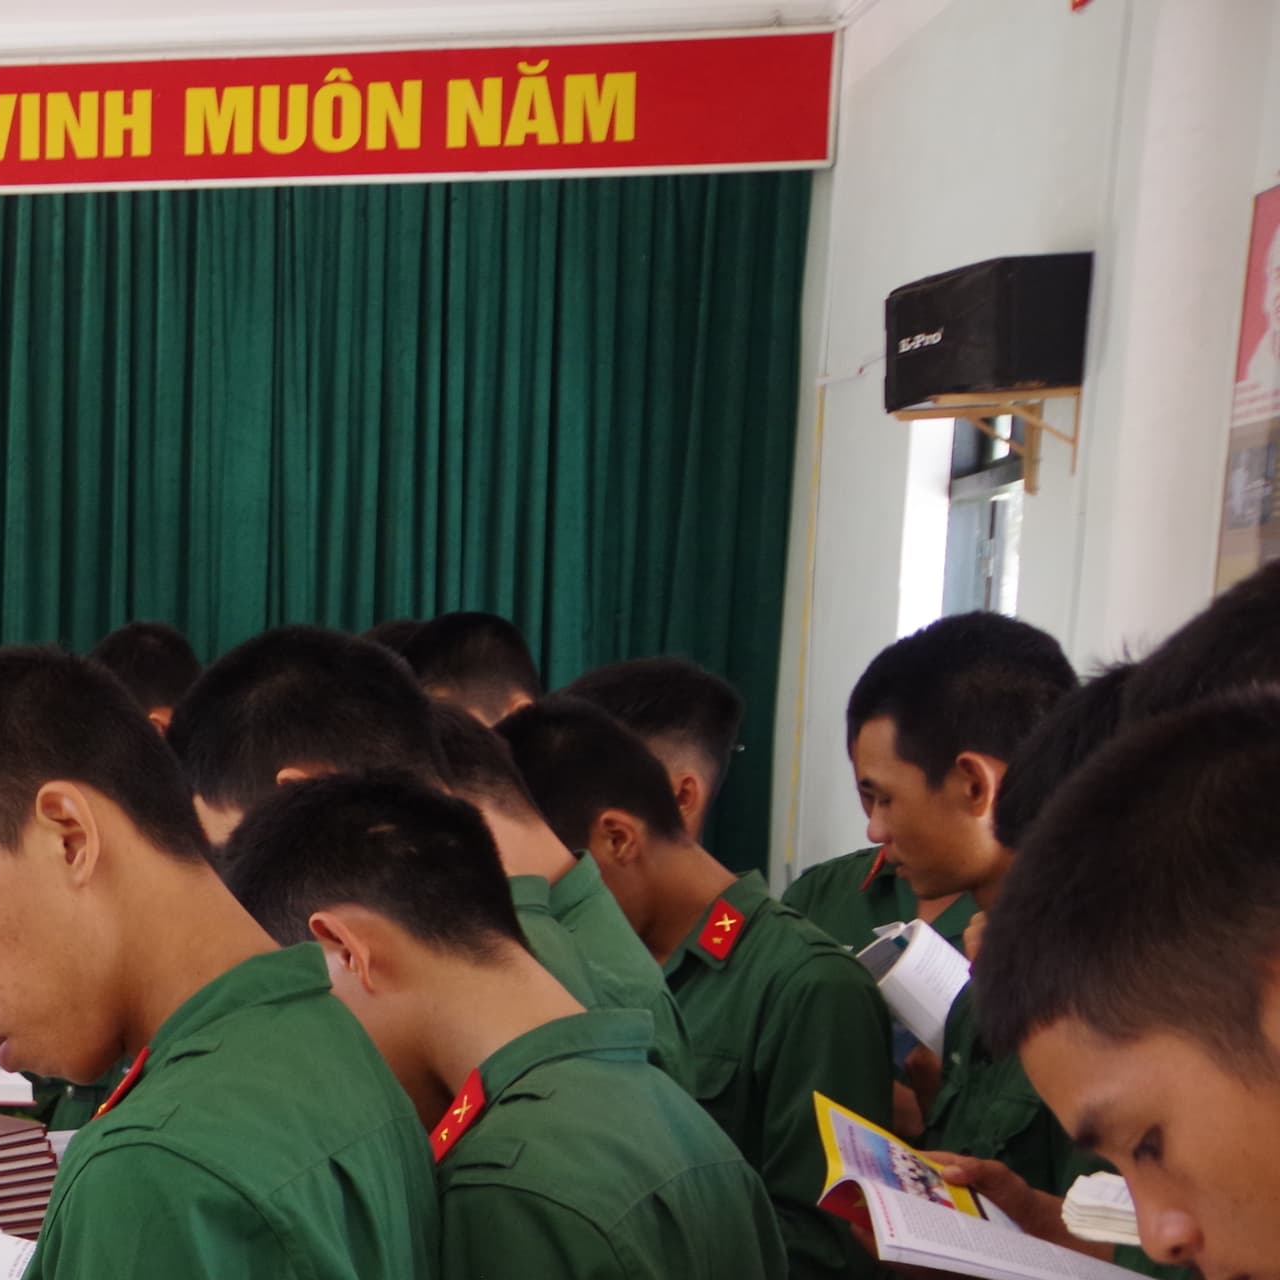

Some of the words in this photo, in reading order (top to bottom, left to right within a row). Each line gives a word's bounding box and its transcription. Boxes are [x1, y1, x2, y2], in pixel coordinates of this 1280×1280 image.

[184, 68, 423, 156] MUÔN
[446, 59, 638, 148] NĂM
[898, 330, 942, 353] K-Pro
